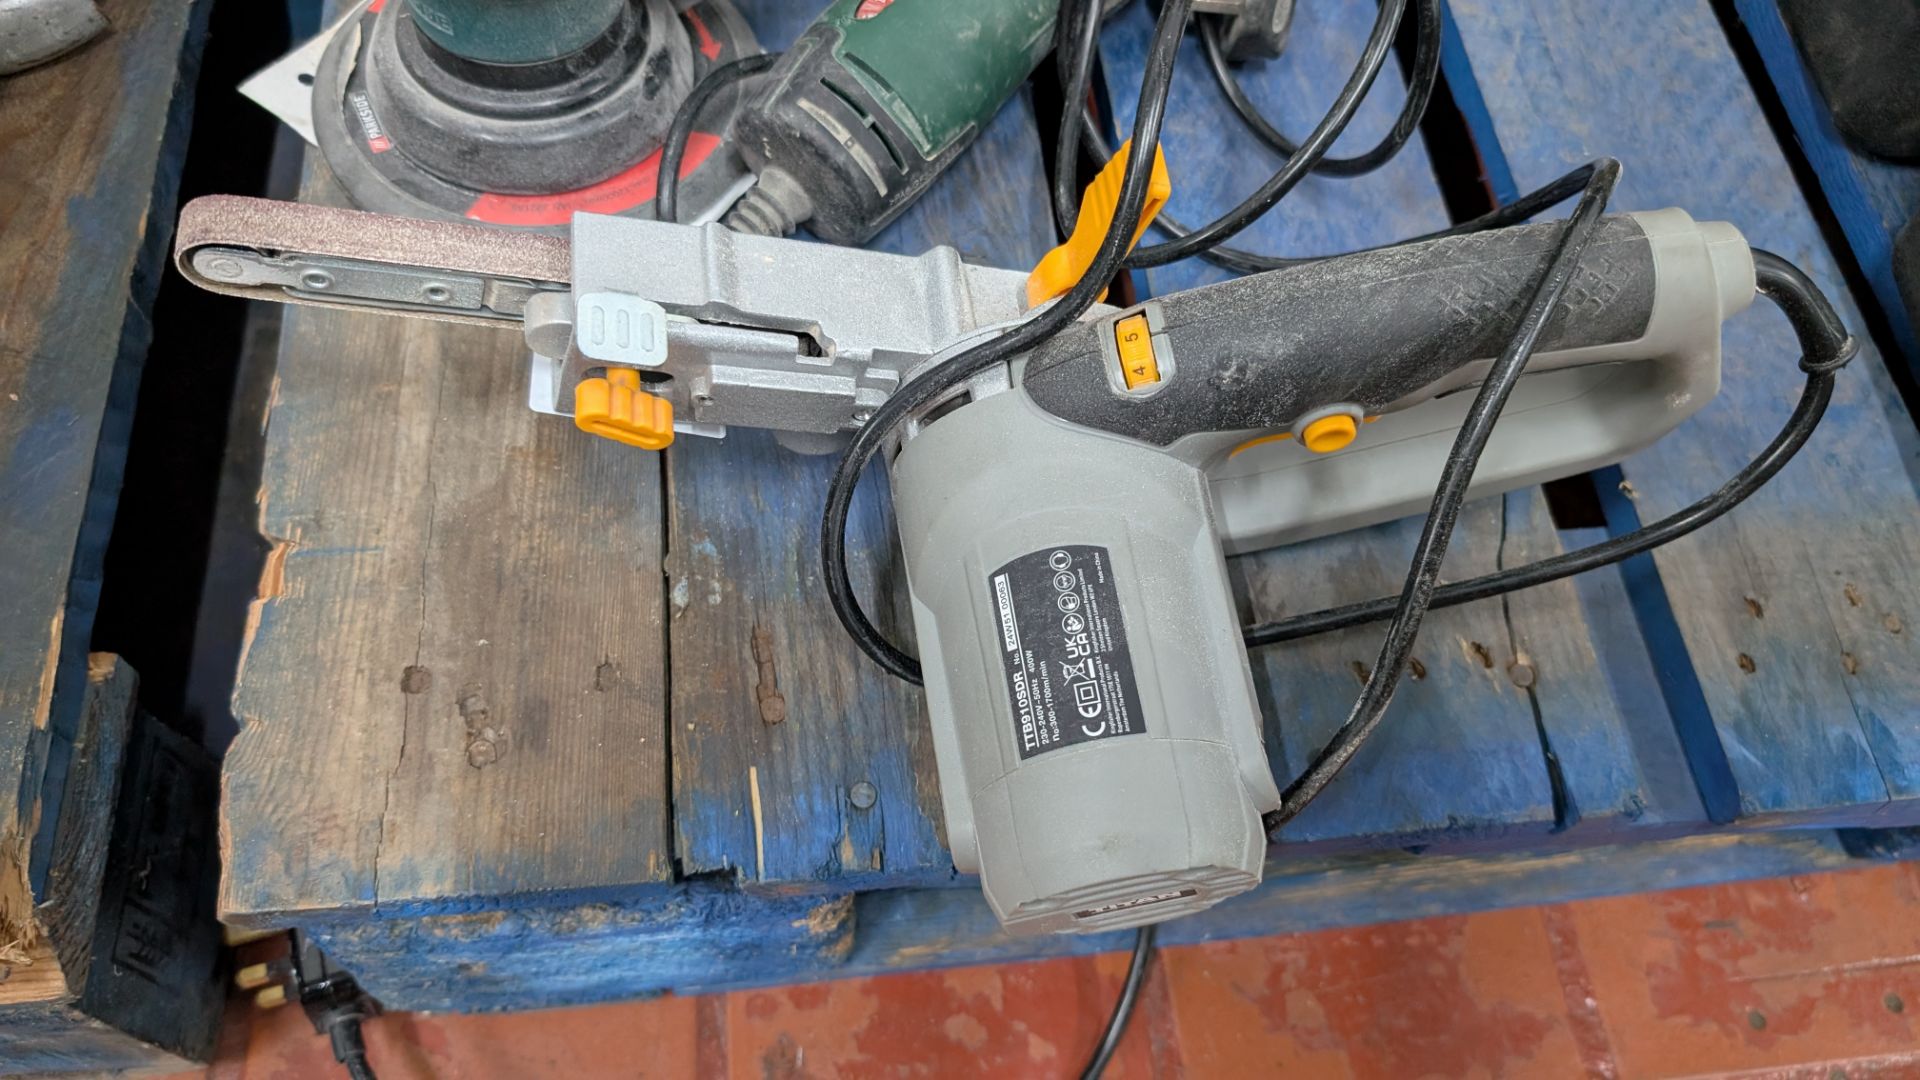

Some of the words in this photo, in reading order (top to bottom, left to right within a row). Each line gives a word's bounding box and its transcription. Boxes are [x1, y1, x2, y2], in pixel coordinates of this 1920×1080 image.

[354, 95, 382, 139] PARKSIDE
[1125, 333, 1139, 342] 5
[1132, 366, 1145, 376] 4
[1064, 635, 1079, 658] UK
[1076, 632, 1090, 656] CA
[1025, 650, 1035, 672] 400W
[1013, 671, 1035, 750] TTB910SDR
